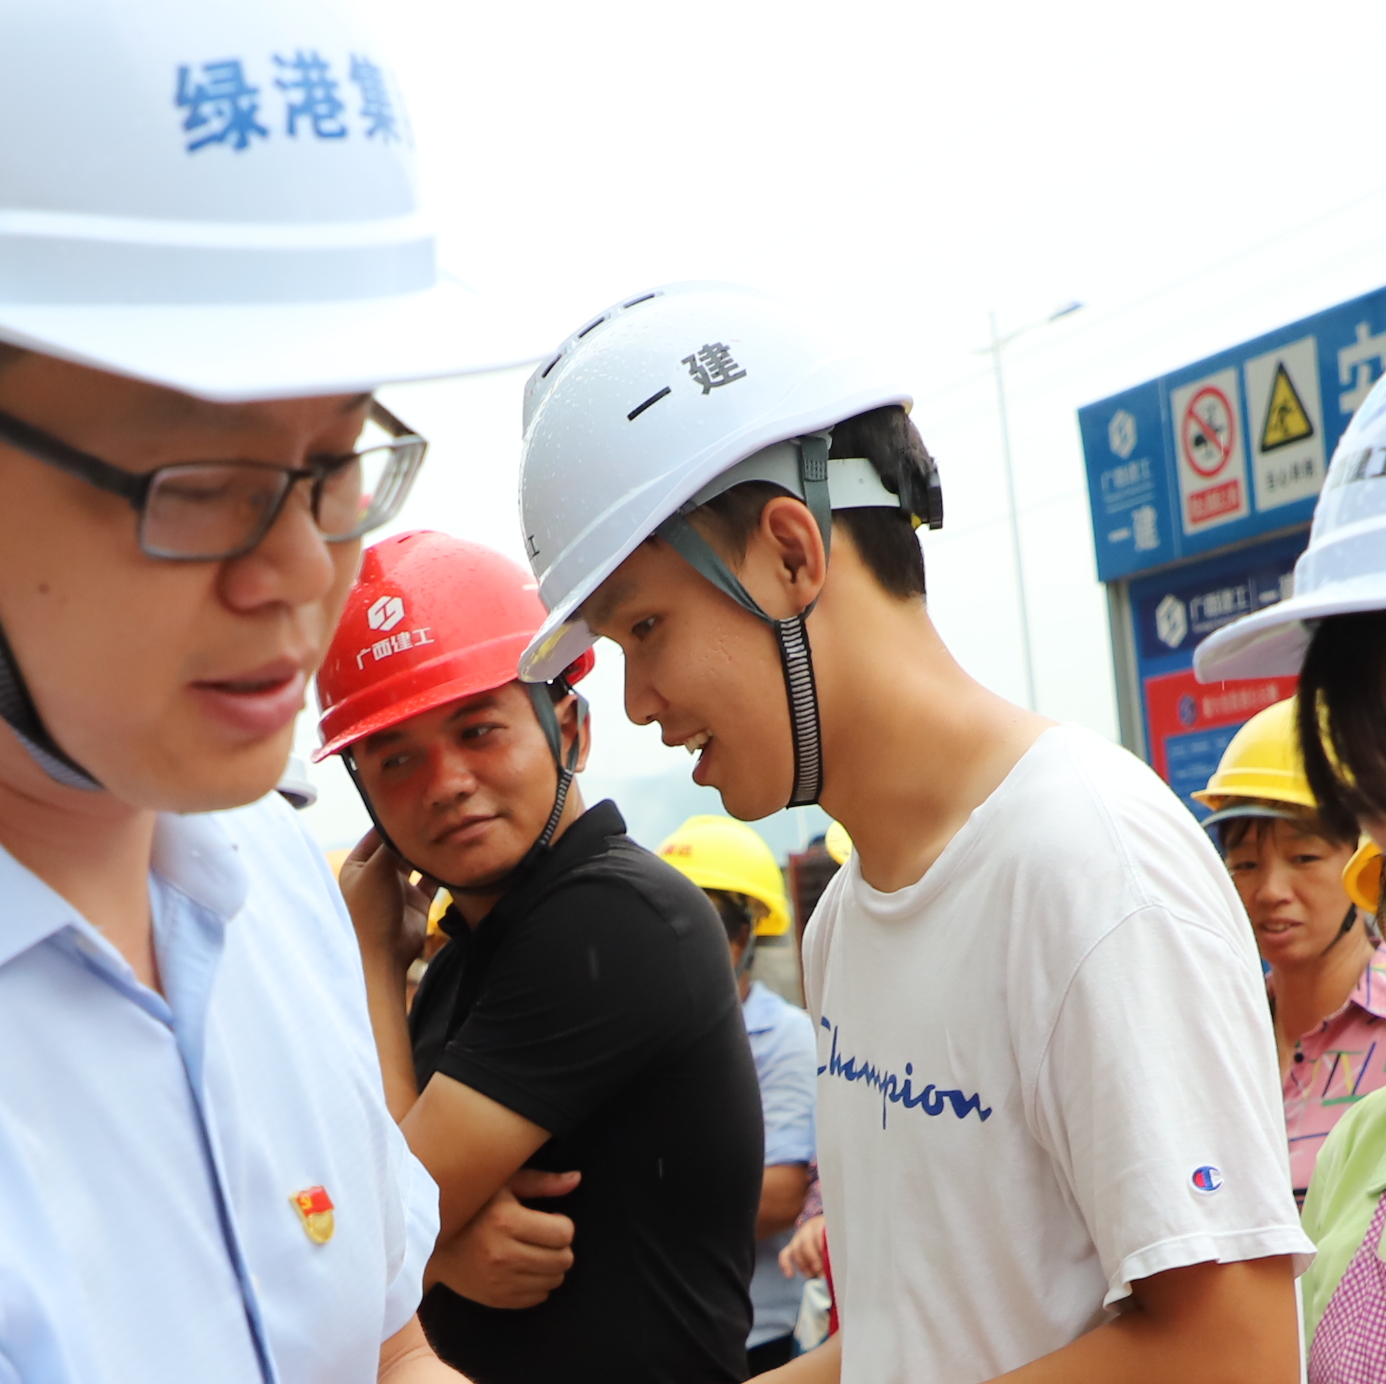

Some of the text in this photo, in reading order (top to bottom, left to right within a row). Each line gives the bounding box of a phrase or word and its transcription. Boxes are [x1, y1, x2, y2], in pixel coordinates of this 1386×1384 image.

[627, 341, 747, 421] 一建
[356, 626, 436, 671] 广西建工
